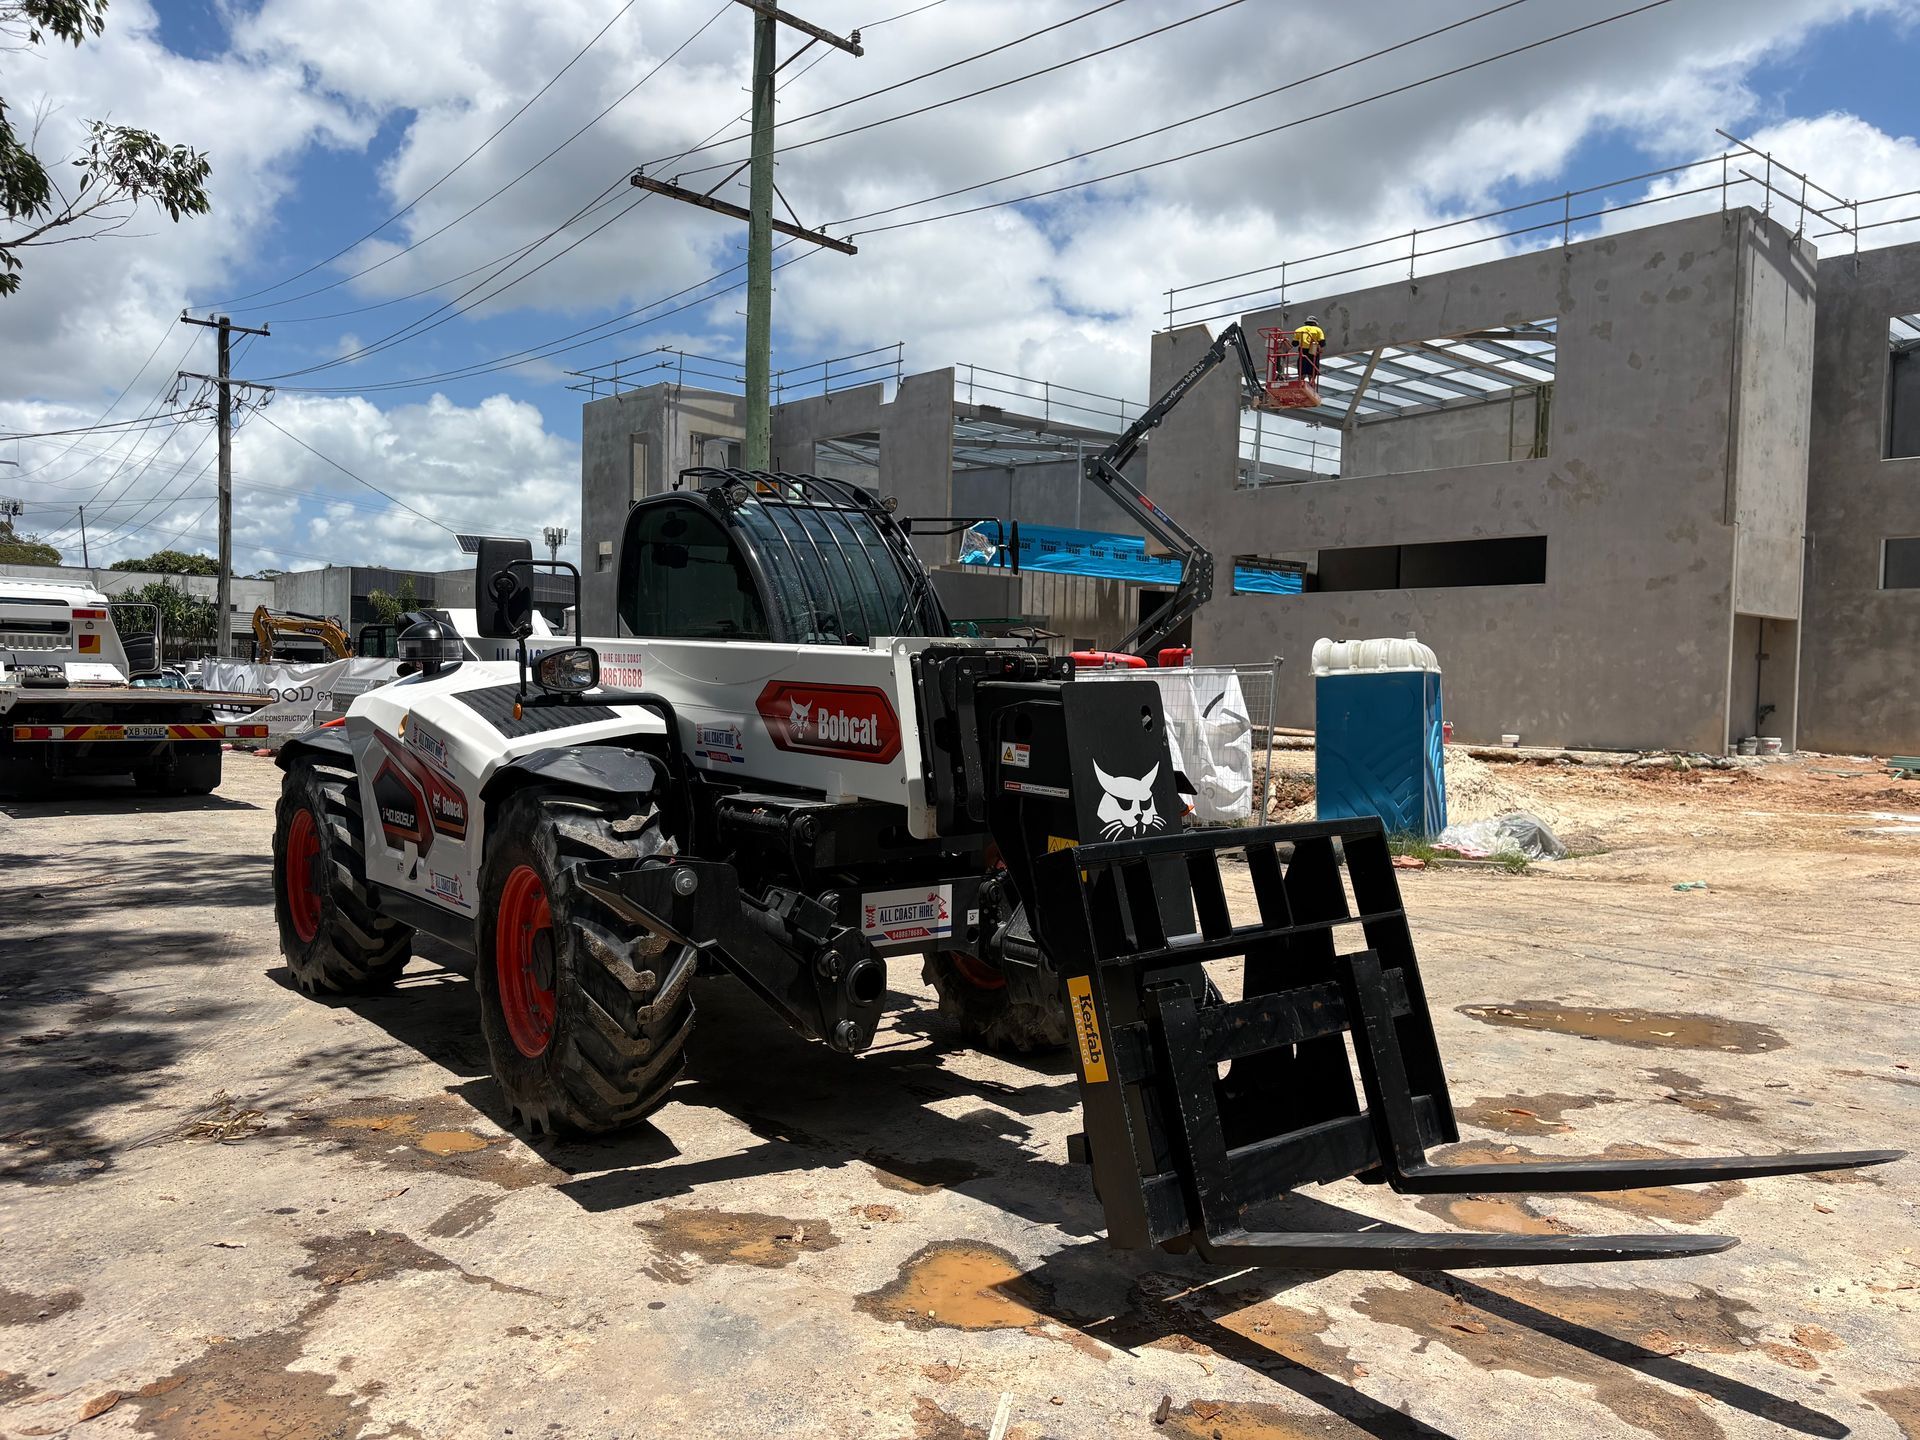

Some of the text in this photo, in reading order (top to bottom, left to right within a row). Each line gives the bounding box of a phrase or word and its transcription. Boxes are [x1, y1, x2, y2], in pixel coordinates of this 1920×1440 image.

[1090, 549, 1104, 558] TRADE
[1113, 552, 1128, 561] TRADE
[603, 653, 613, 663] HIRE
[615, 653, 626, 663] GOLD
[627, 653, 642, 664] COAST
[818, 708, 878, 746] Bobcat
[442, 796, 464, 819] Bobcat
[880, 904, 934, 923] ALL COAST HIRE
[1079, 992, 1102, 1064] Kerfab
